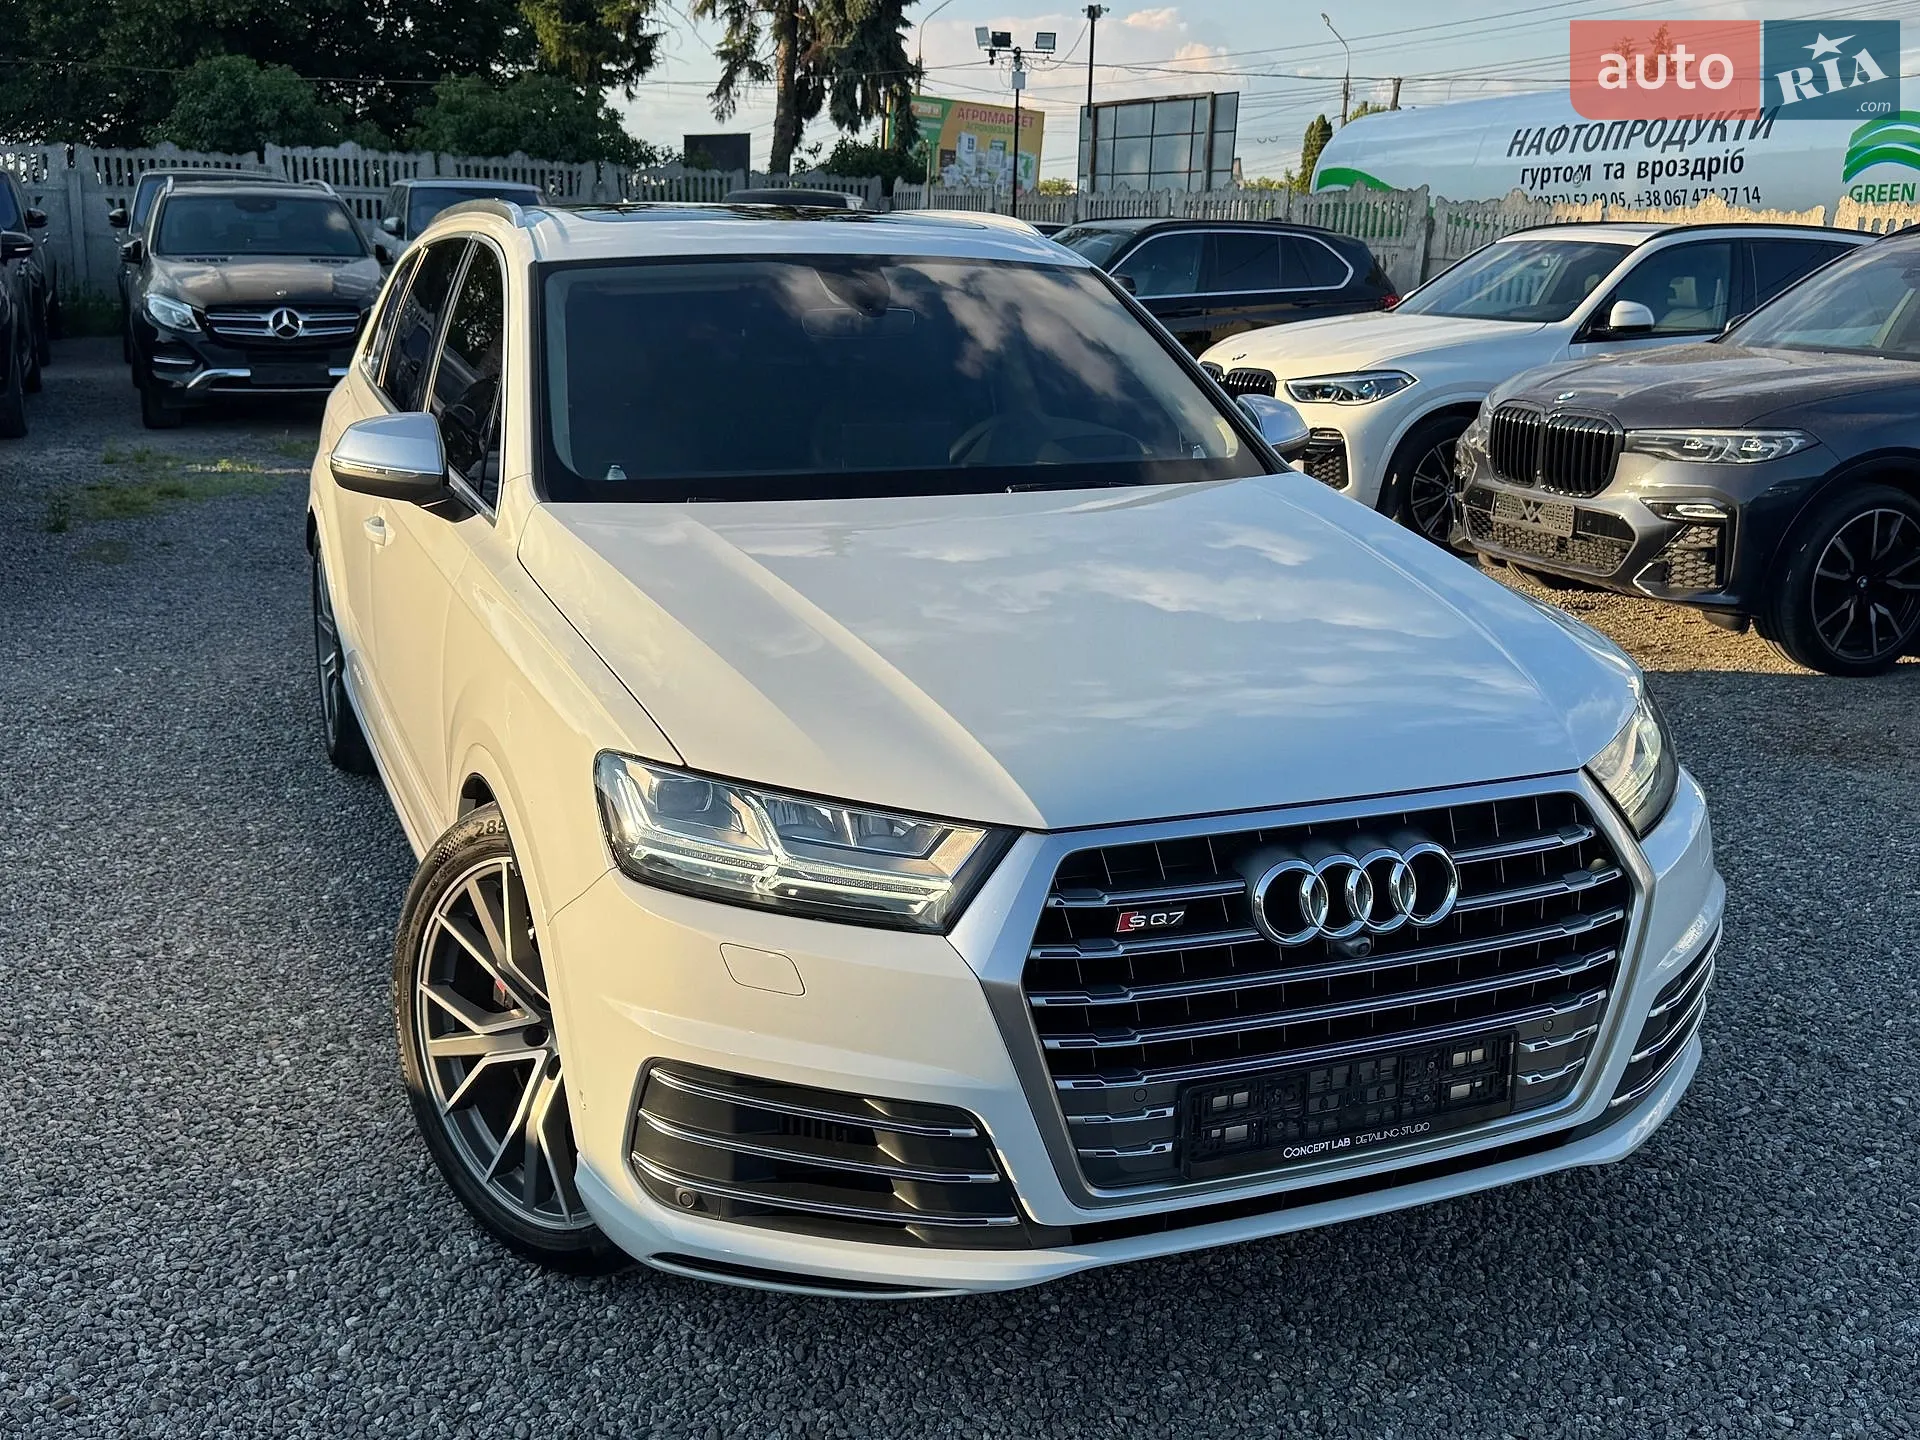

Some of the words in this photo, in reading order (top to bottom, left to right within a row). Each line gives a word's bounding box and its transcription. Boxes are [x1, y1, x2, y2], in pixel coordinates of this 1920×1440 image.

[1507, 106, 1779, 157] НАФТОПРОДУКТИ
[1521, 164, 1591, 190] гуртом
[1603, 162, 1625, 180] та
[1636, 148, 1744, 184] вроздріб
[1634, 190, 1661, 207] +38
[1664, 189, 1687, 206] 067
[1743, 186, 1761, 203] 14
[1849, 183, 1916, 202] GREEN
[1128, 911, 1185, 928] SQ7
[1283, 1141, 1330, 1158] CONCEPT
[1331, 1137, 1351, 1150] LAB
[1400, 1122, 1430, 1135] STUDIO
